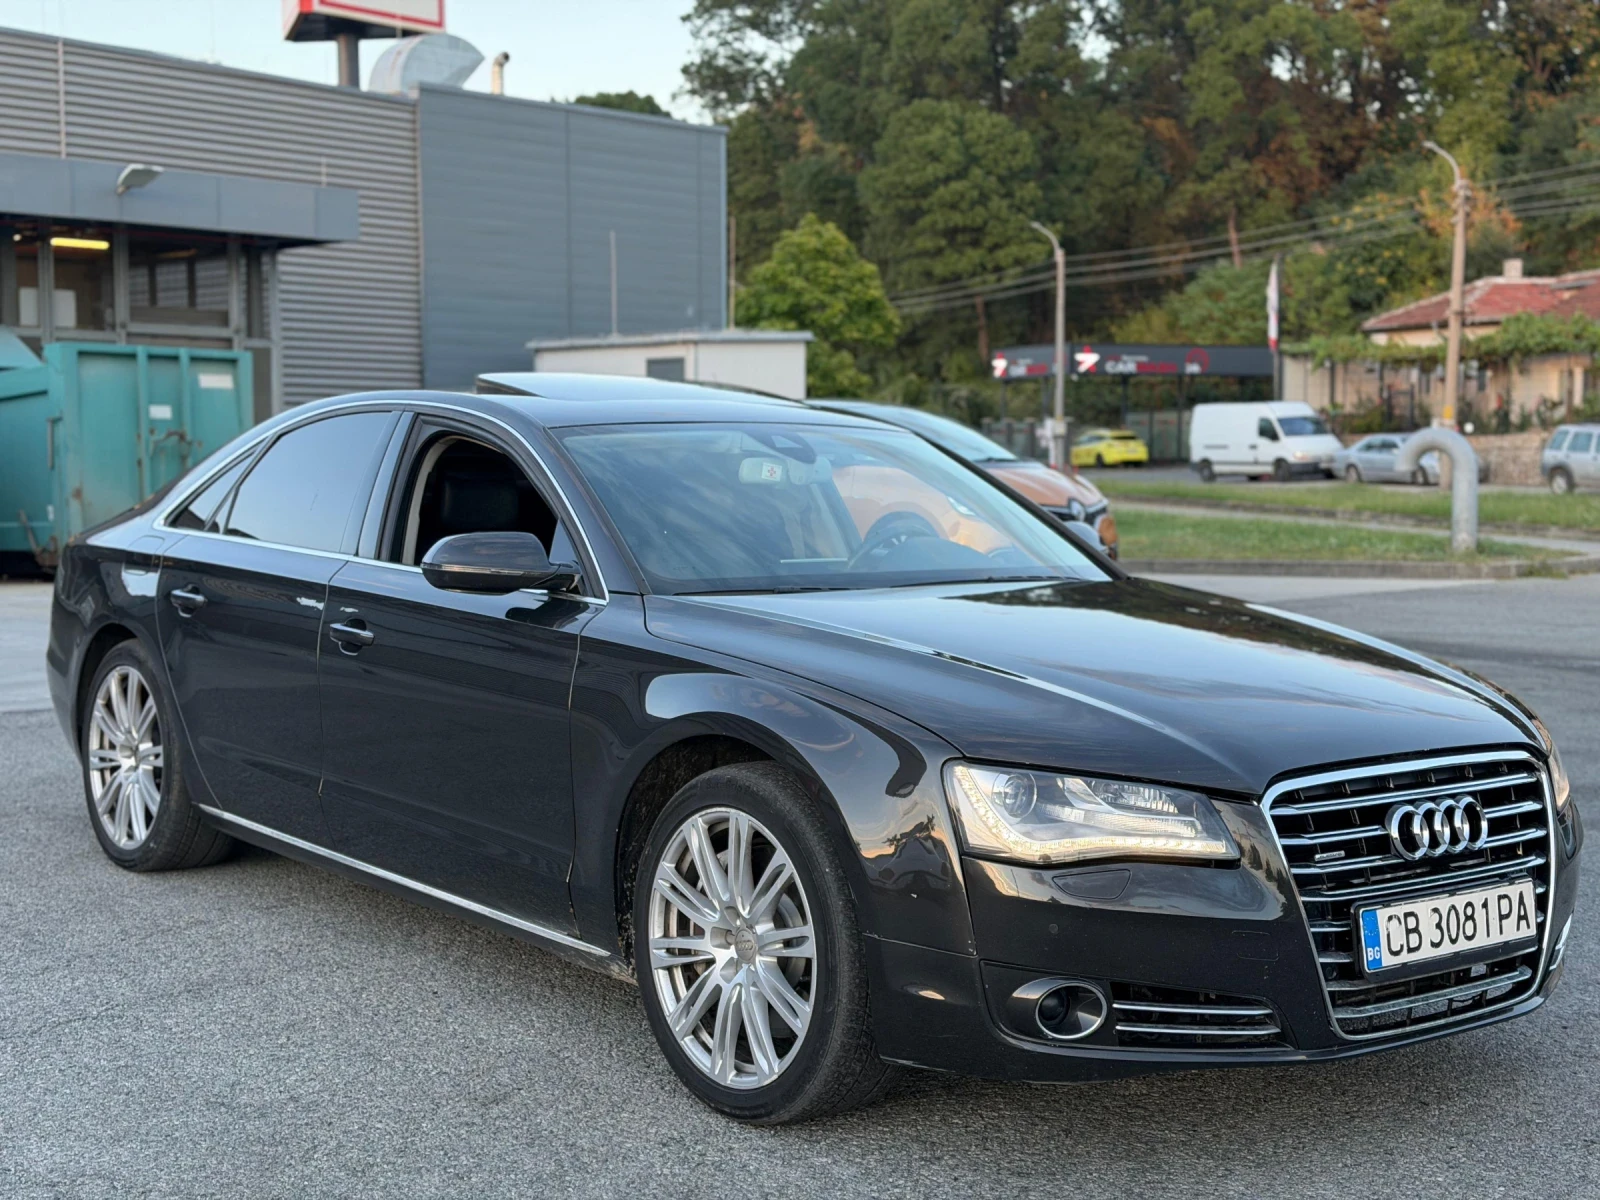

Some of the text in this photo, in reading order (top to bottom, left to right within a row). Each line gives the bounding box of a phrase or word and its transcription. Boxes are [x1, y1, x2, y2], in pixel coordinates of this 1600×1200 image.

[1385, 891, 1531, 957] CB 3081 PA
[1367, 946, 1381, 961] BG
